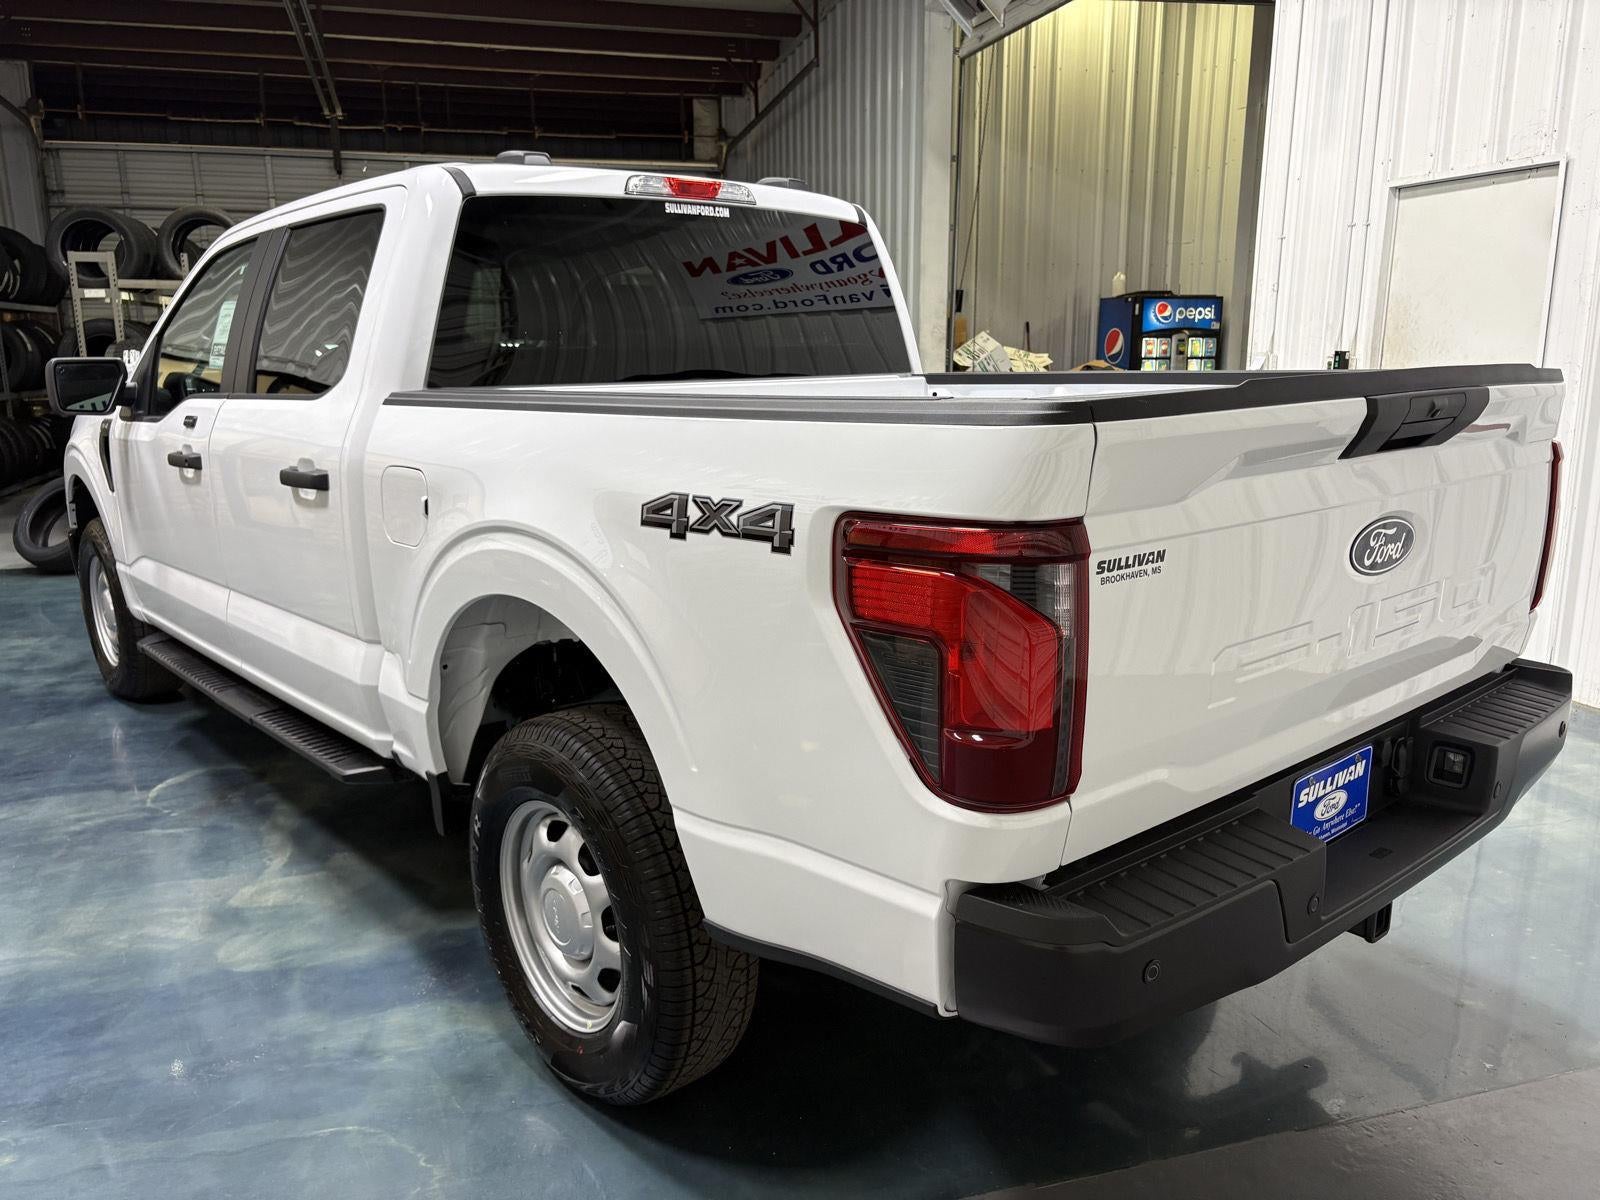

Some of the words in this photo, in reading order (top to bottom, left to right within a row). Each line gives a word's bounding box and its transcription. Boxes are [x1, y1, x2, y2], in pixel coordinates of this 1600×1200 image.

[665, 202, 730, 218] SULLIVANFORD.COM
[1175, 304, 1215, 323] pepsi
[1364, 527, 1406, 567] Ford
[1095, 549, 1166, 576] SULLIVAN
[1100, 569, 1150, 586] BROOKHAVEN,
[1151, 566, 1162, 575] MS
[1298, 760, 1366, 808] SULLIVAN
